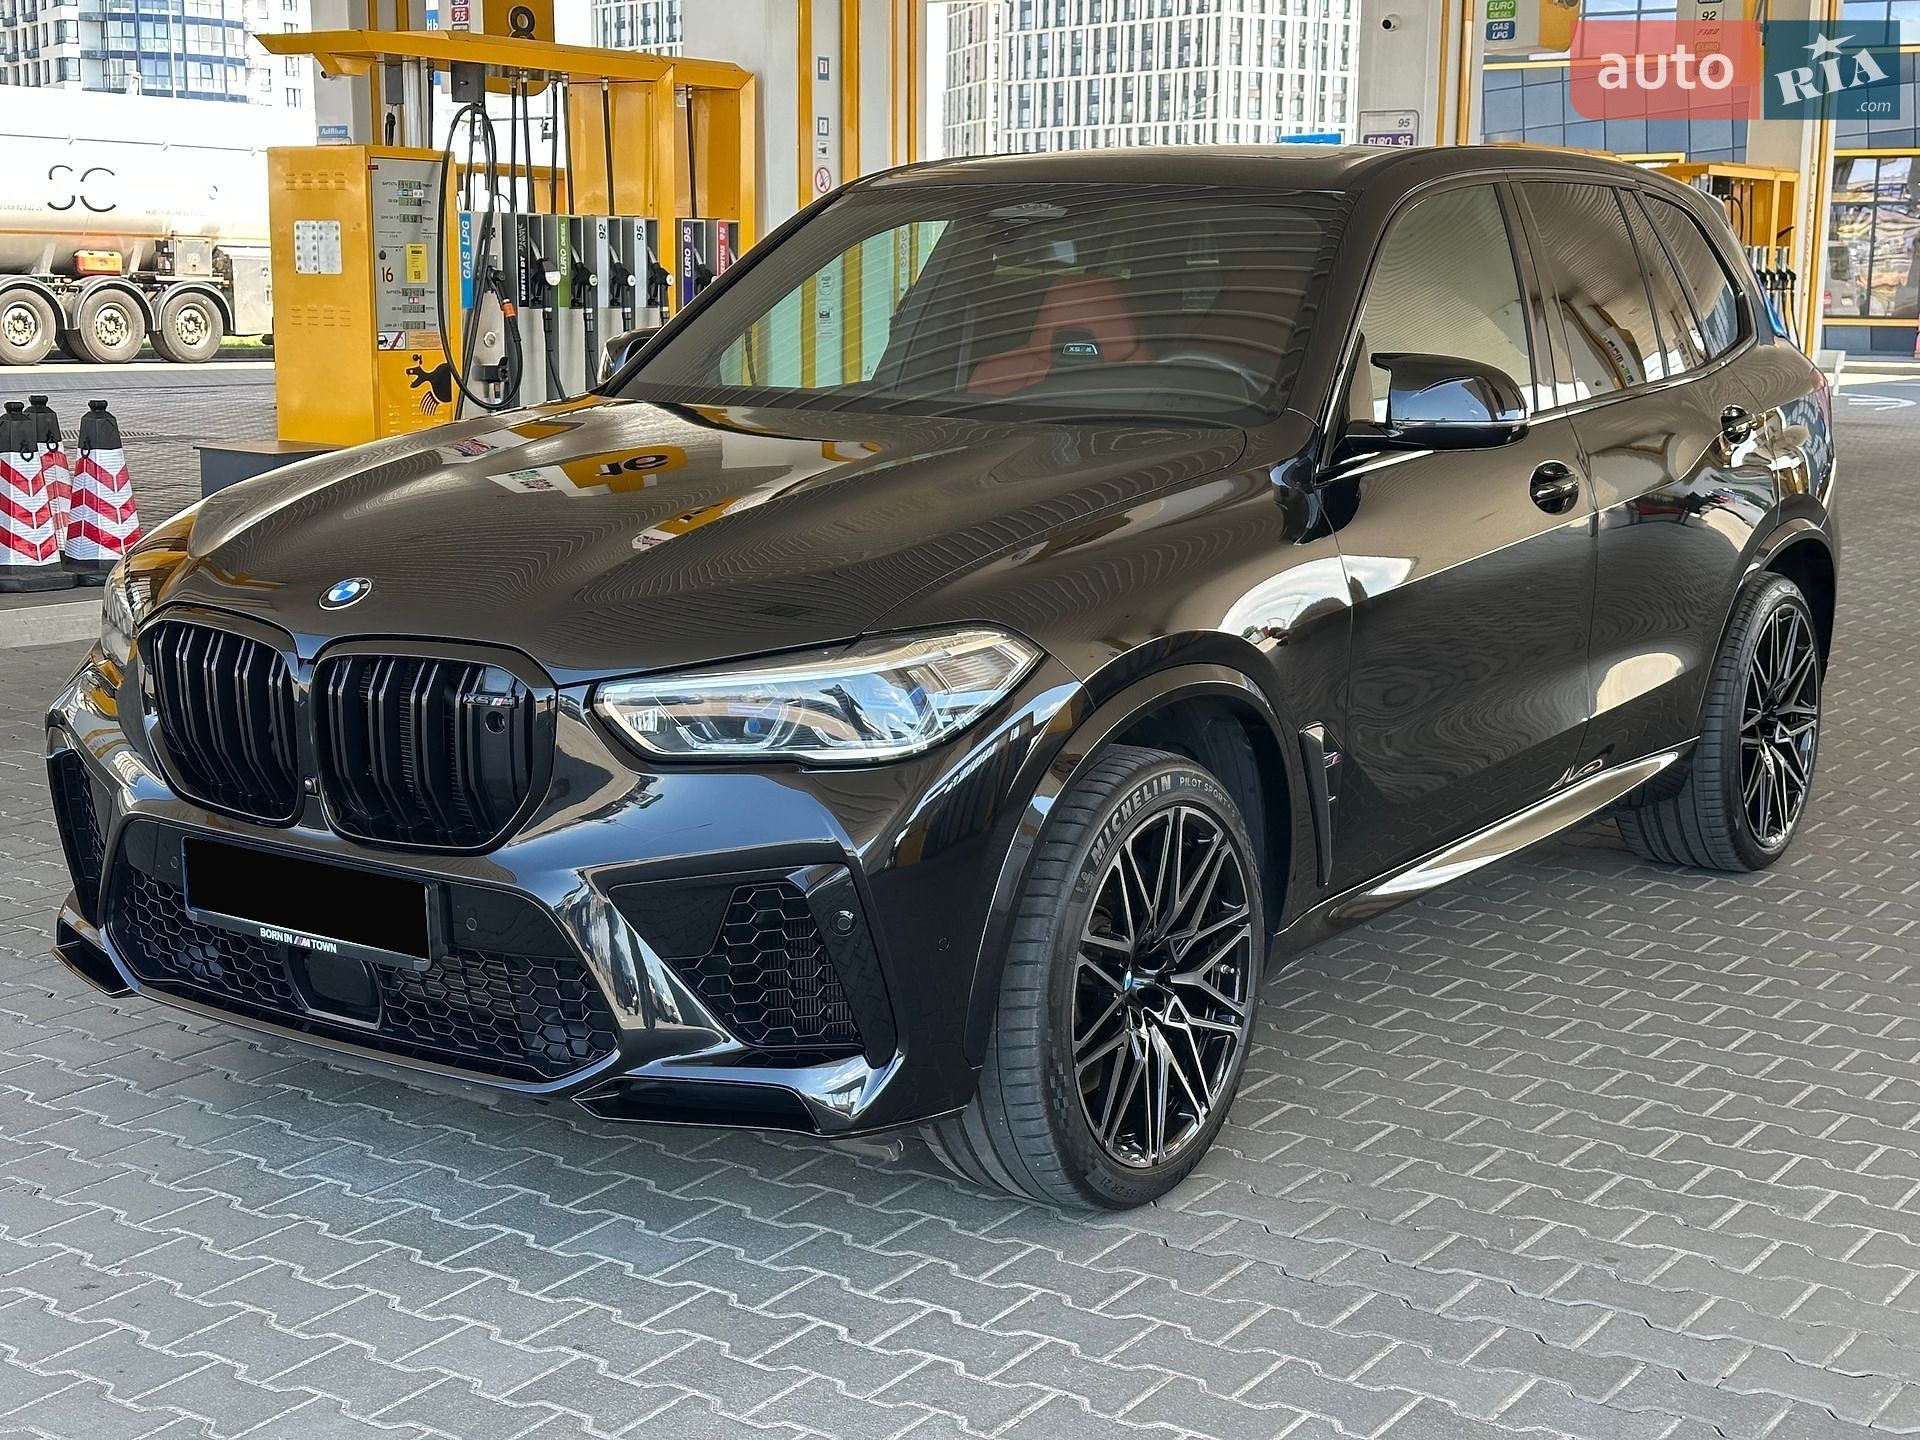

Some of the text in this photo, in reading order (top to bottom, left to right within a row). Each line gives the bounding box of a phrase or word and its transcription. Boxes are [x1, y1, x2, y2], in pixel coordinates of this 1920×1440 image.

[1489, 1, 1515, 10] EURO
[454, 12, 466, 21] 95
[1701, 11, 1717, 21] 92
[1492, 22, 1510, 30] GAS
[1492, 31, 1509, 39] LPG
[1398, 118, 1410, 128] 95
[598, 223, 607, 240] 92
[636, 224, 645, 241] 95
[461, 220, 471, 279] GAS LPG
[683, 226, 692, 278] EURO 95
[381, 266, 394, 283] 16
[1179, 776, 1228, 805] PILOT SPORT
[1091, 774, 1172, 867] MICHELIN
[260, 927, 284, 942] BORN
[283, 933, 293, 944] IN
[311, 939, 337, 954] TOWN
